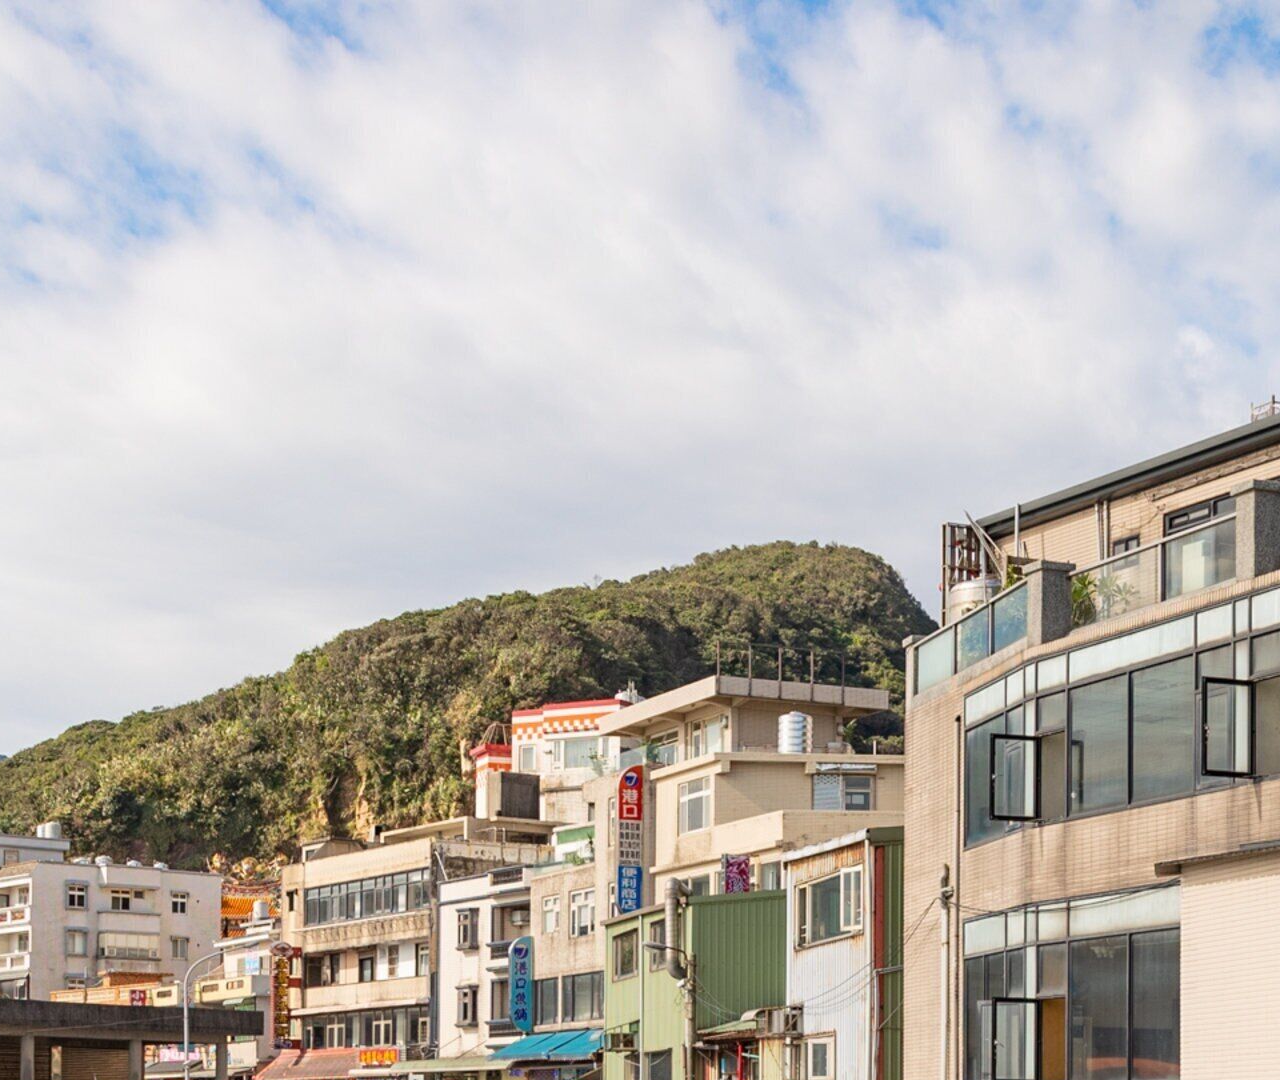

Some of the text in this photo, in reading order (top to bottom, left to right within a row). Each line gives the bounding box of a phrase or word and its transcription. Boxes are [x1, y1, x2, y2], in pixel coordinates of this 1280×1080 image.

[622, 788, 639, 818] 港口
[621, 867, 638, 910] 便利商店
